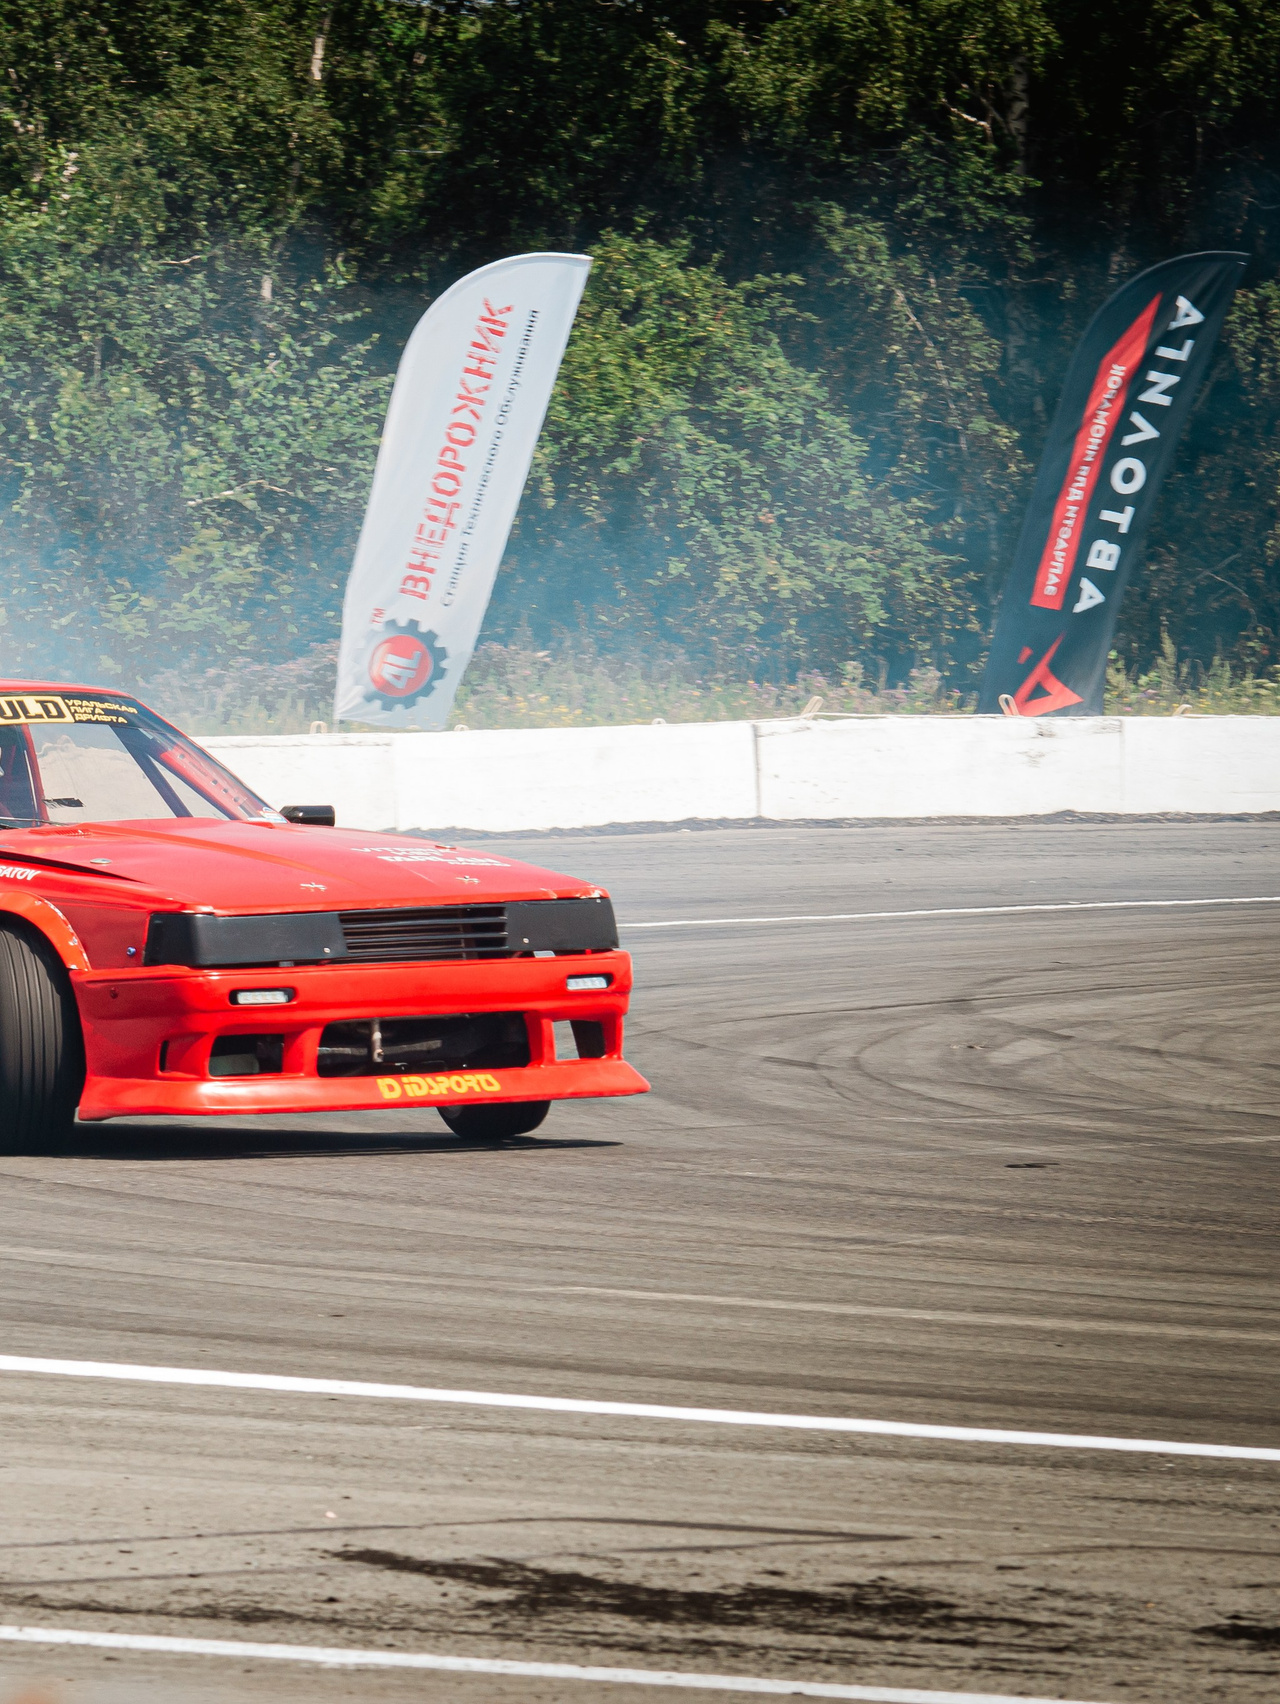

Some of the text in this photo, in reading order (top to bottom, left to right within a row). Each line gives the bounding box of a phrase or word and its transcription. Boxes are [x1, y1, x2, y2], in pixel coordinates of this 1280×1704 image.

[398, 297, 515, 600] ВНЕДОРОЖНИК
[440, 309, 540, 607] Станция Технического Обслуживания
[381, 651, 422, 689] 4L
